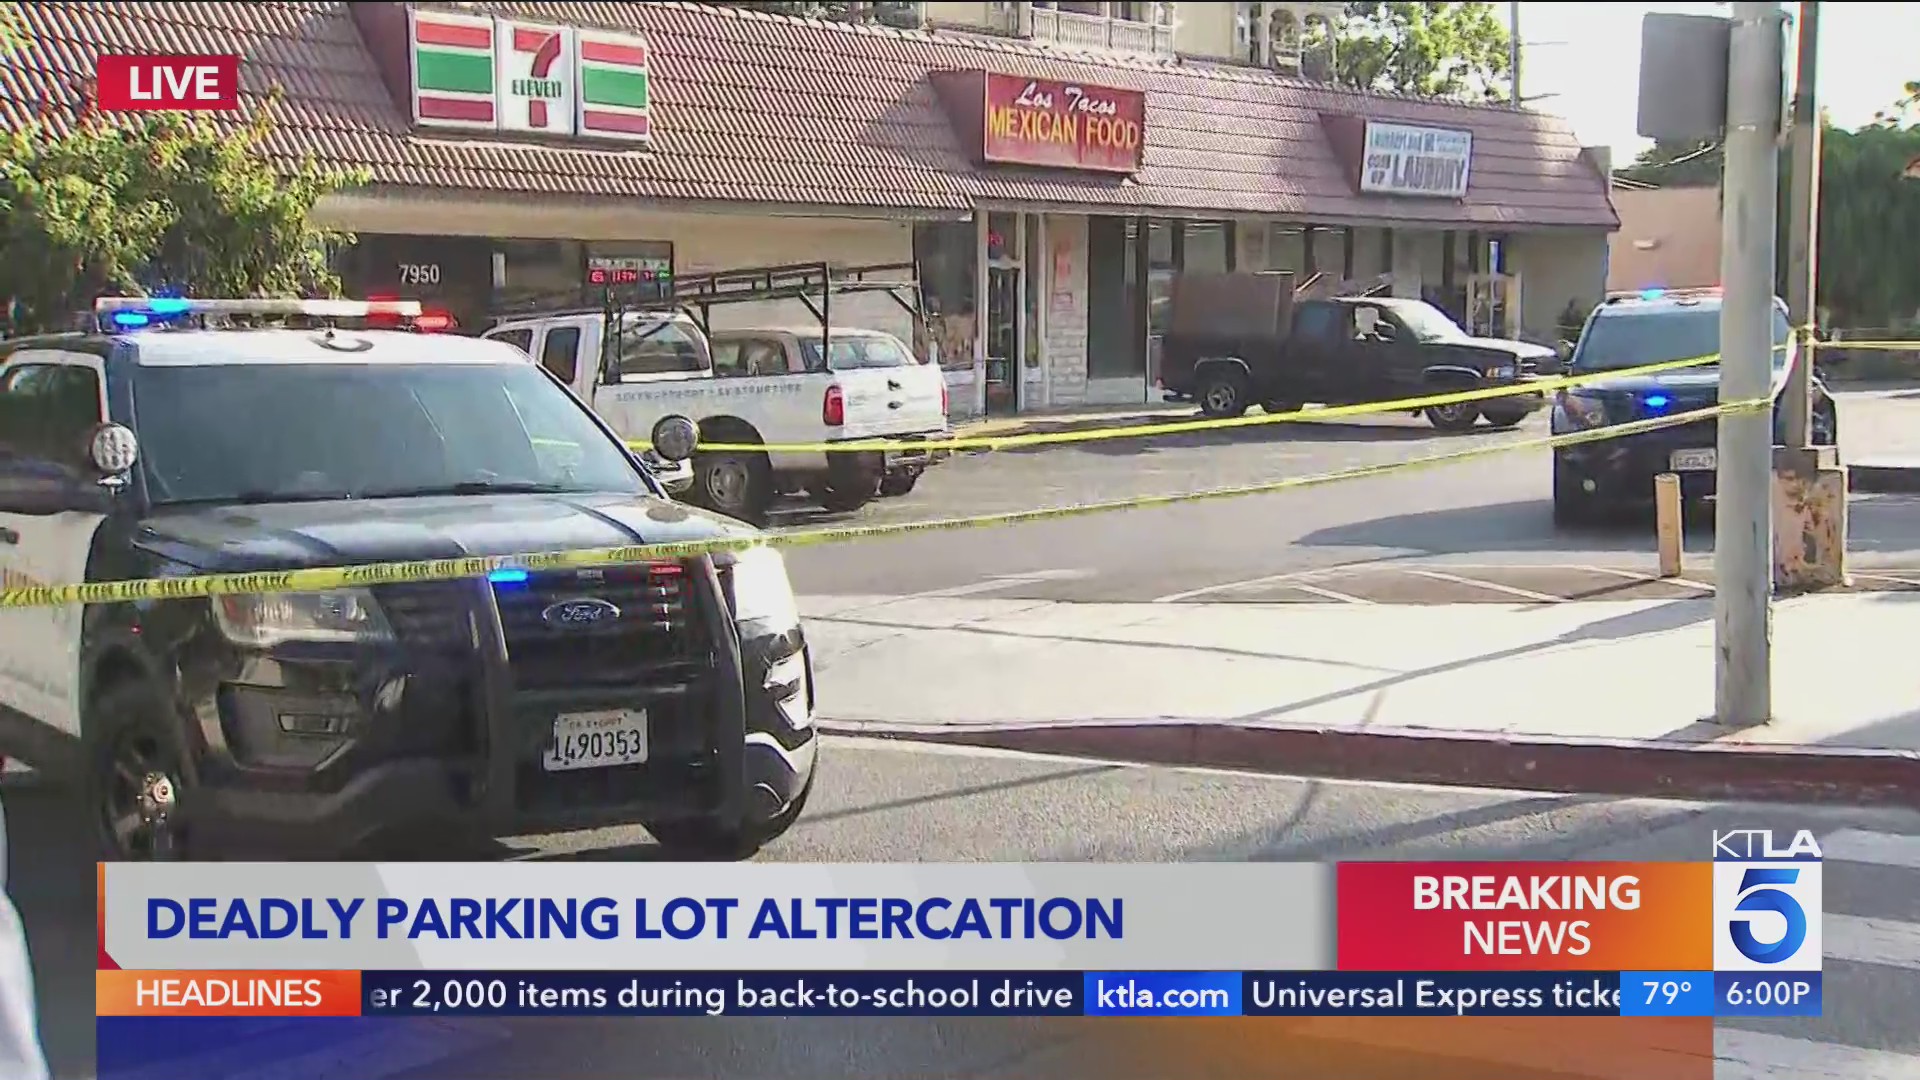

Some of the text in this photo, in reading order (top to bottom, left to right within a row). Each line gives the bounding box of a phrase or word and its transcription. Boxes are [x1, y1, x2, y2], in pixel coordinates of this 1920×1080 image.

[513, 27, 561, 127] 7
[1015, 82, 1117, 115] Los Tacos
[989, 106, 1139, 149] MEXICAN FOOD
[1391, 153, 1465, 191] LAUNDRY
[399, 263, 440, 284] 7950
[561, 604, 603, 622] Ford
[551, 728, 641, 762] 1490353
